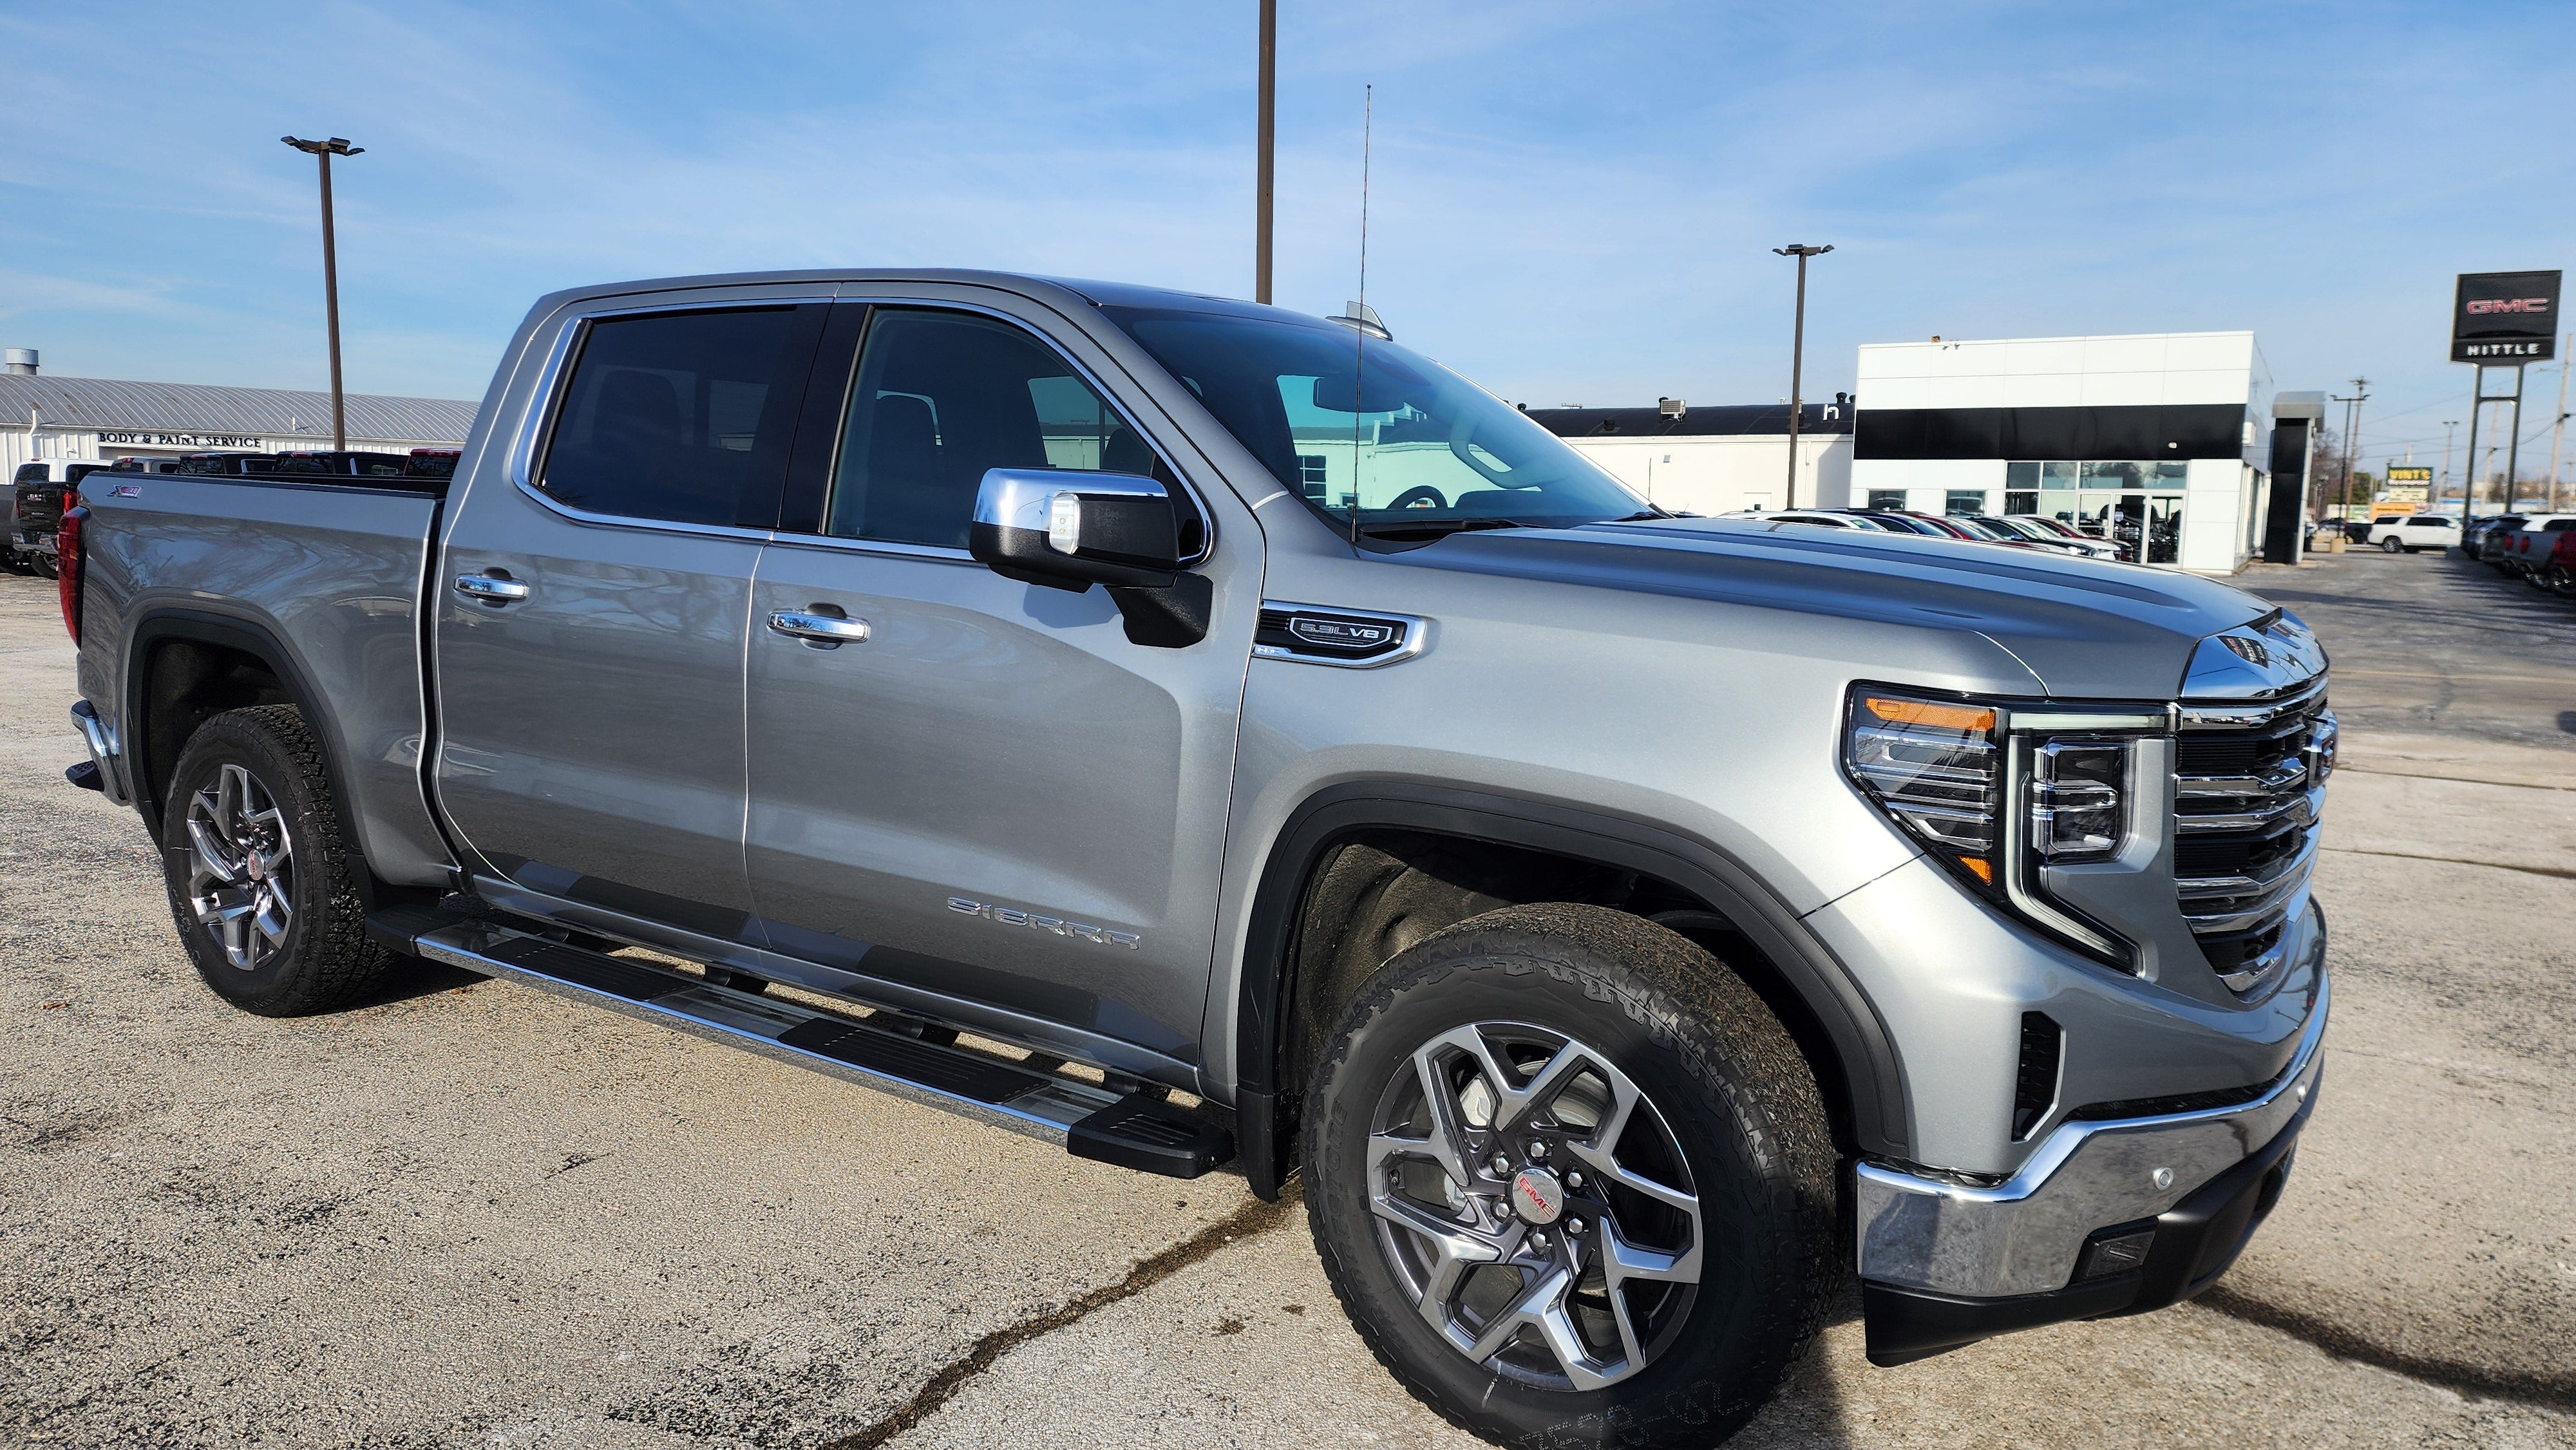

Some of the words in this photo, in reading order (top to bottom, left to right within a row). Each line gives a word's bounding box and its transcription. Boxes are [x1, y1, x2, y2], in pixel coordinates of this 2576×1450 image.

[2467, 297, 2550, 315] GMC
[2467, 343, 2541, 356] HITTLE
[99, 433, 137, 443] BODY
[142, 434, 151, 444] &
[158, 435, 198, 446] PAINT
[206, 437, 261, 447] SERVICE
[948, 896, 1140, 950] SIERRA
[1519, 1176, 1556, 1219] GMC
